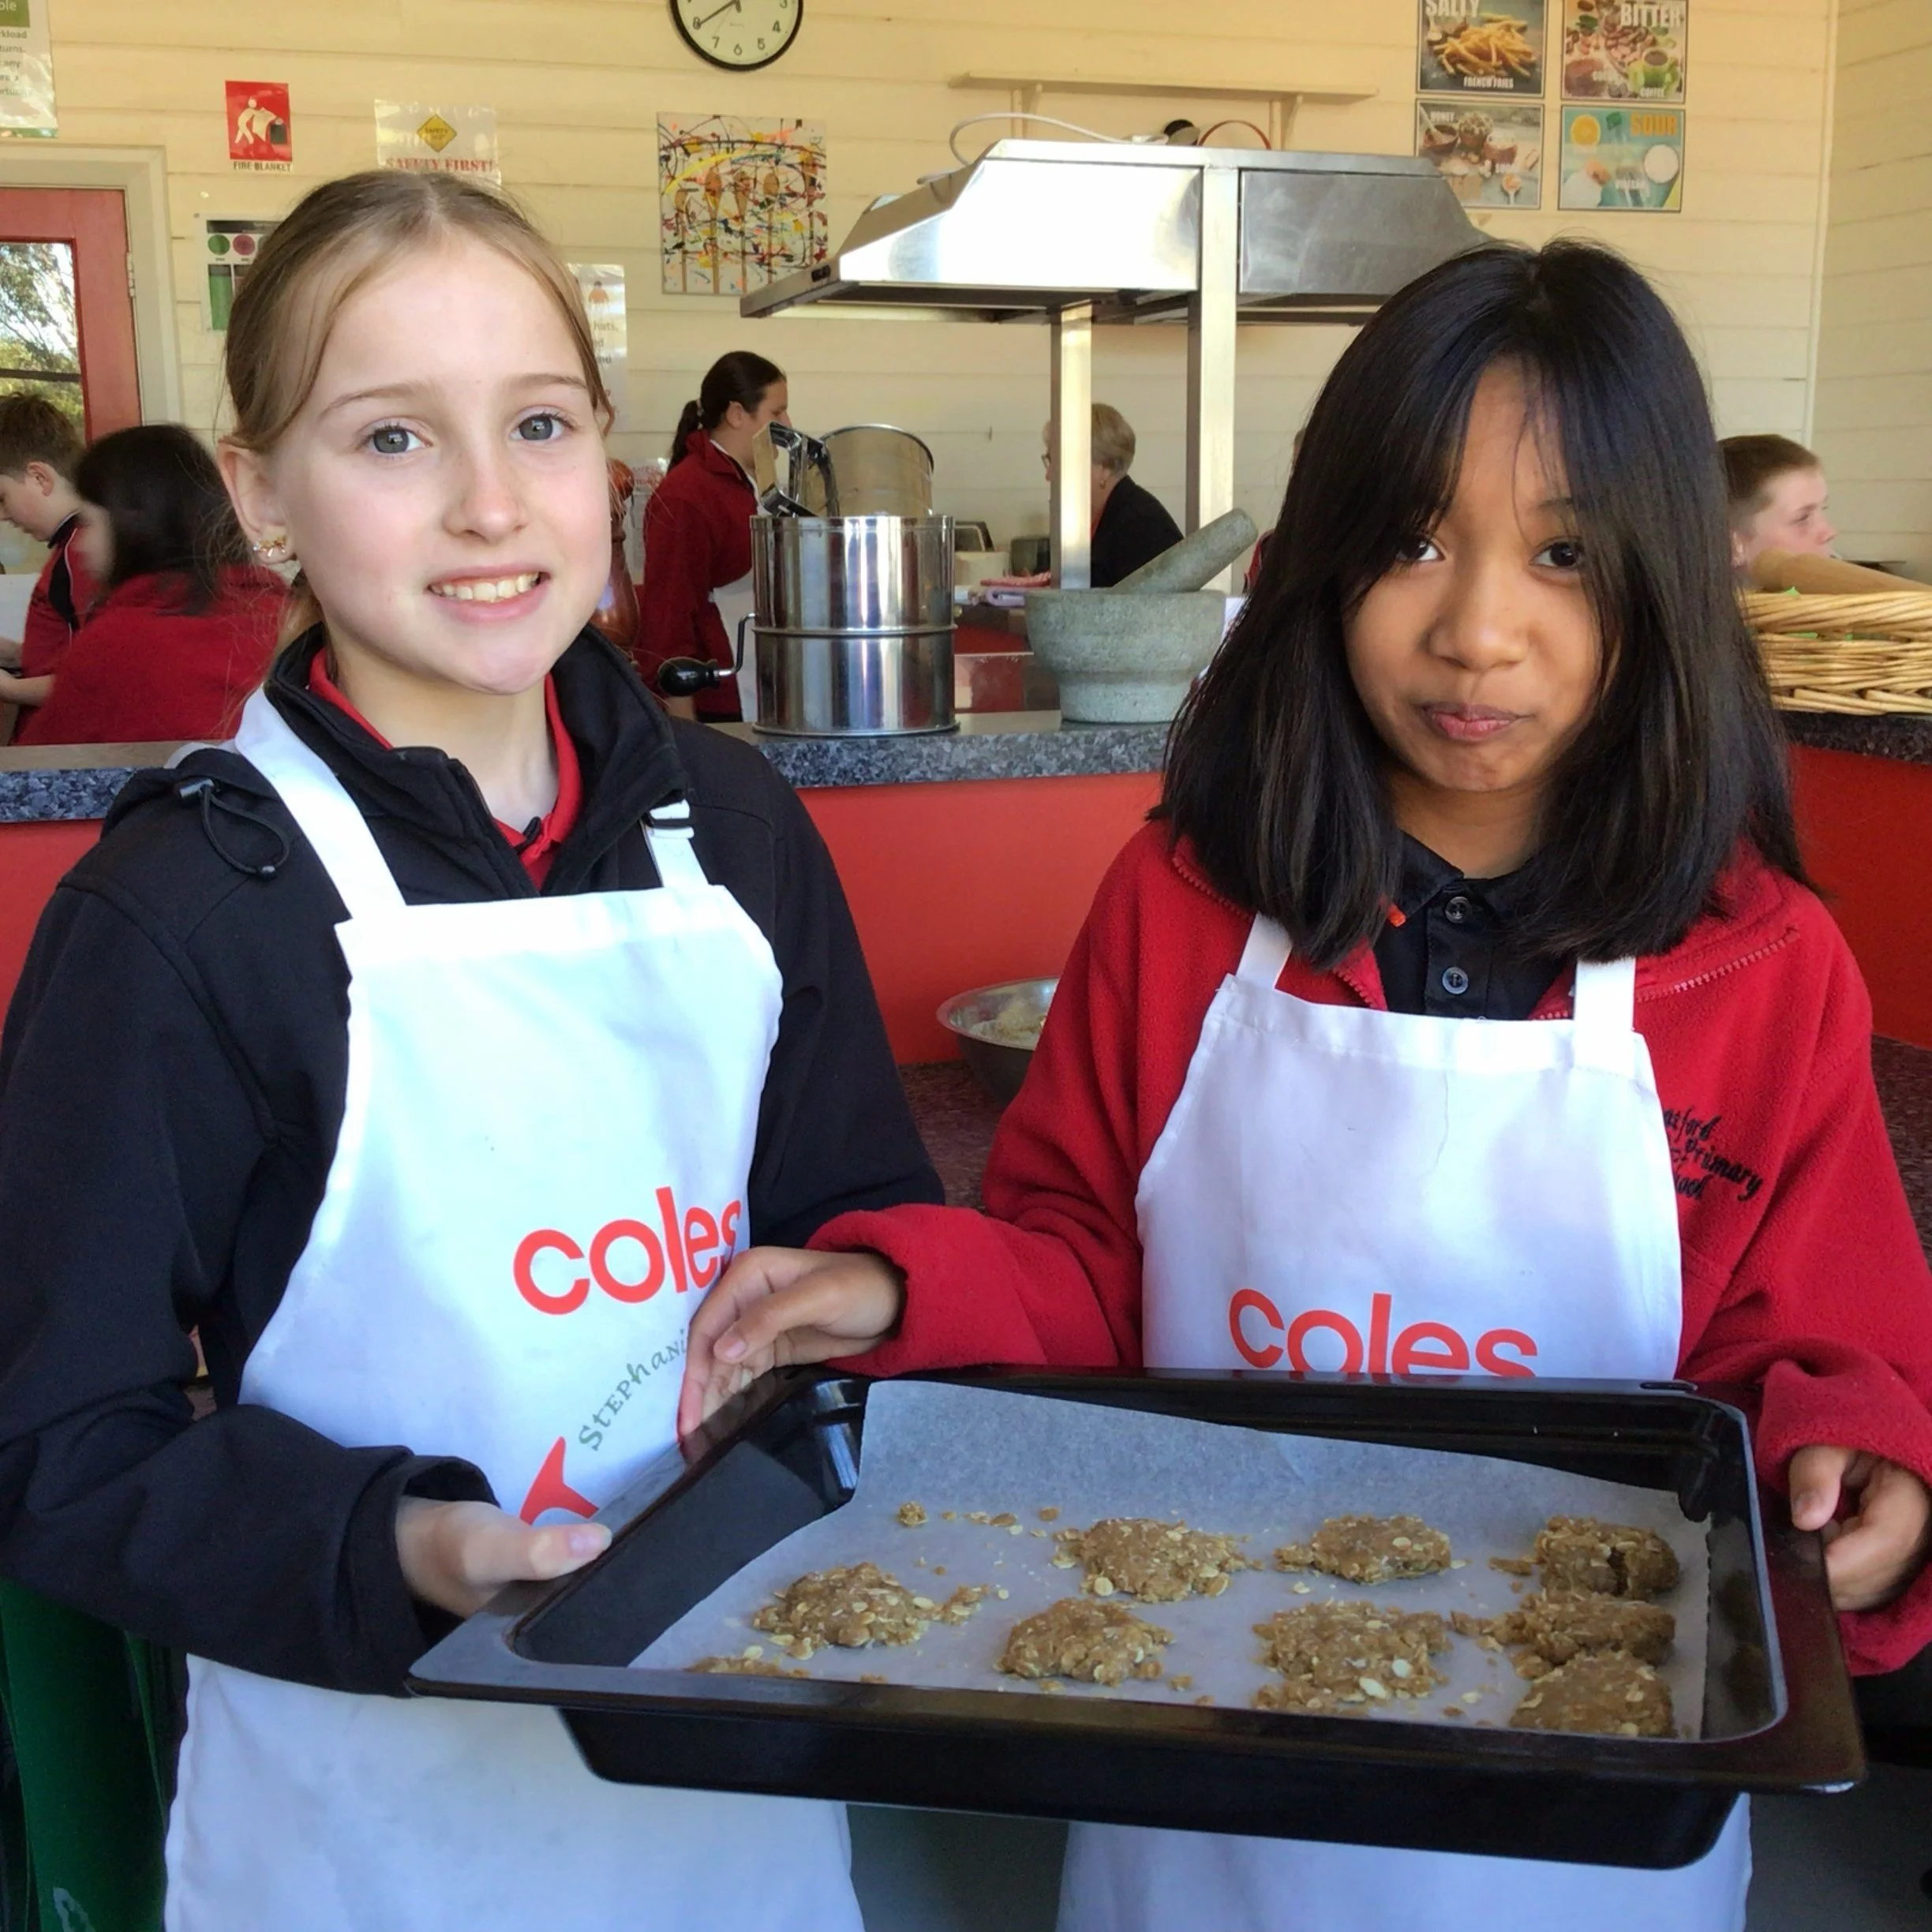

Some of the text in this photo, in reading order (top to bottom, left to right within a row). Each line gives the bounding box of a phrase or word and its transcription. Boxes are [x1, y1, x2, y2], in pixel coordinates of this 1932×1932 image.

[1425, 0, 1480, 17] SALTY
[1620, 3, 1684, 27] BITTER
[772, 20, 781, 33] 4
[712, 36, 720, 48] 7
[734, 43, 743, 56] 6
[758, 38, 766, 51] 5
[1630, 111, 1678, 137] SOUR
[1684, 1138, 1764, 1202] Primary
[513, 1185, 741, 1315] coles
[1229, 1288, 1537, 1377] coles
[578, 1328, 687, 1451] Stephani
